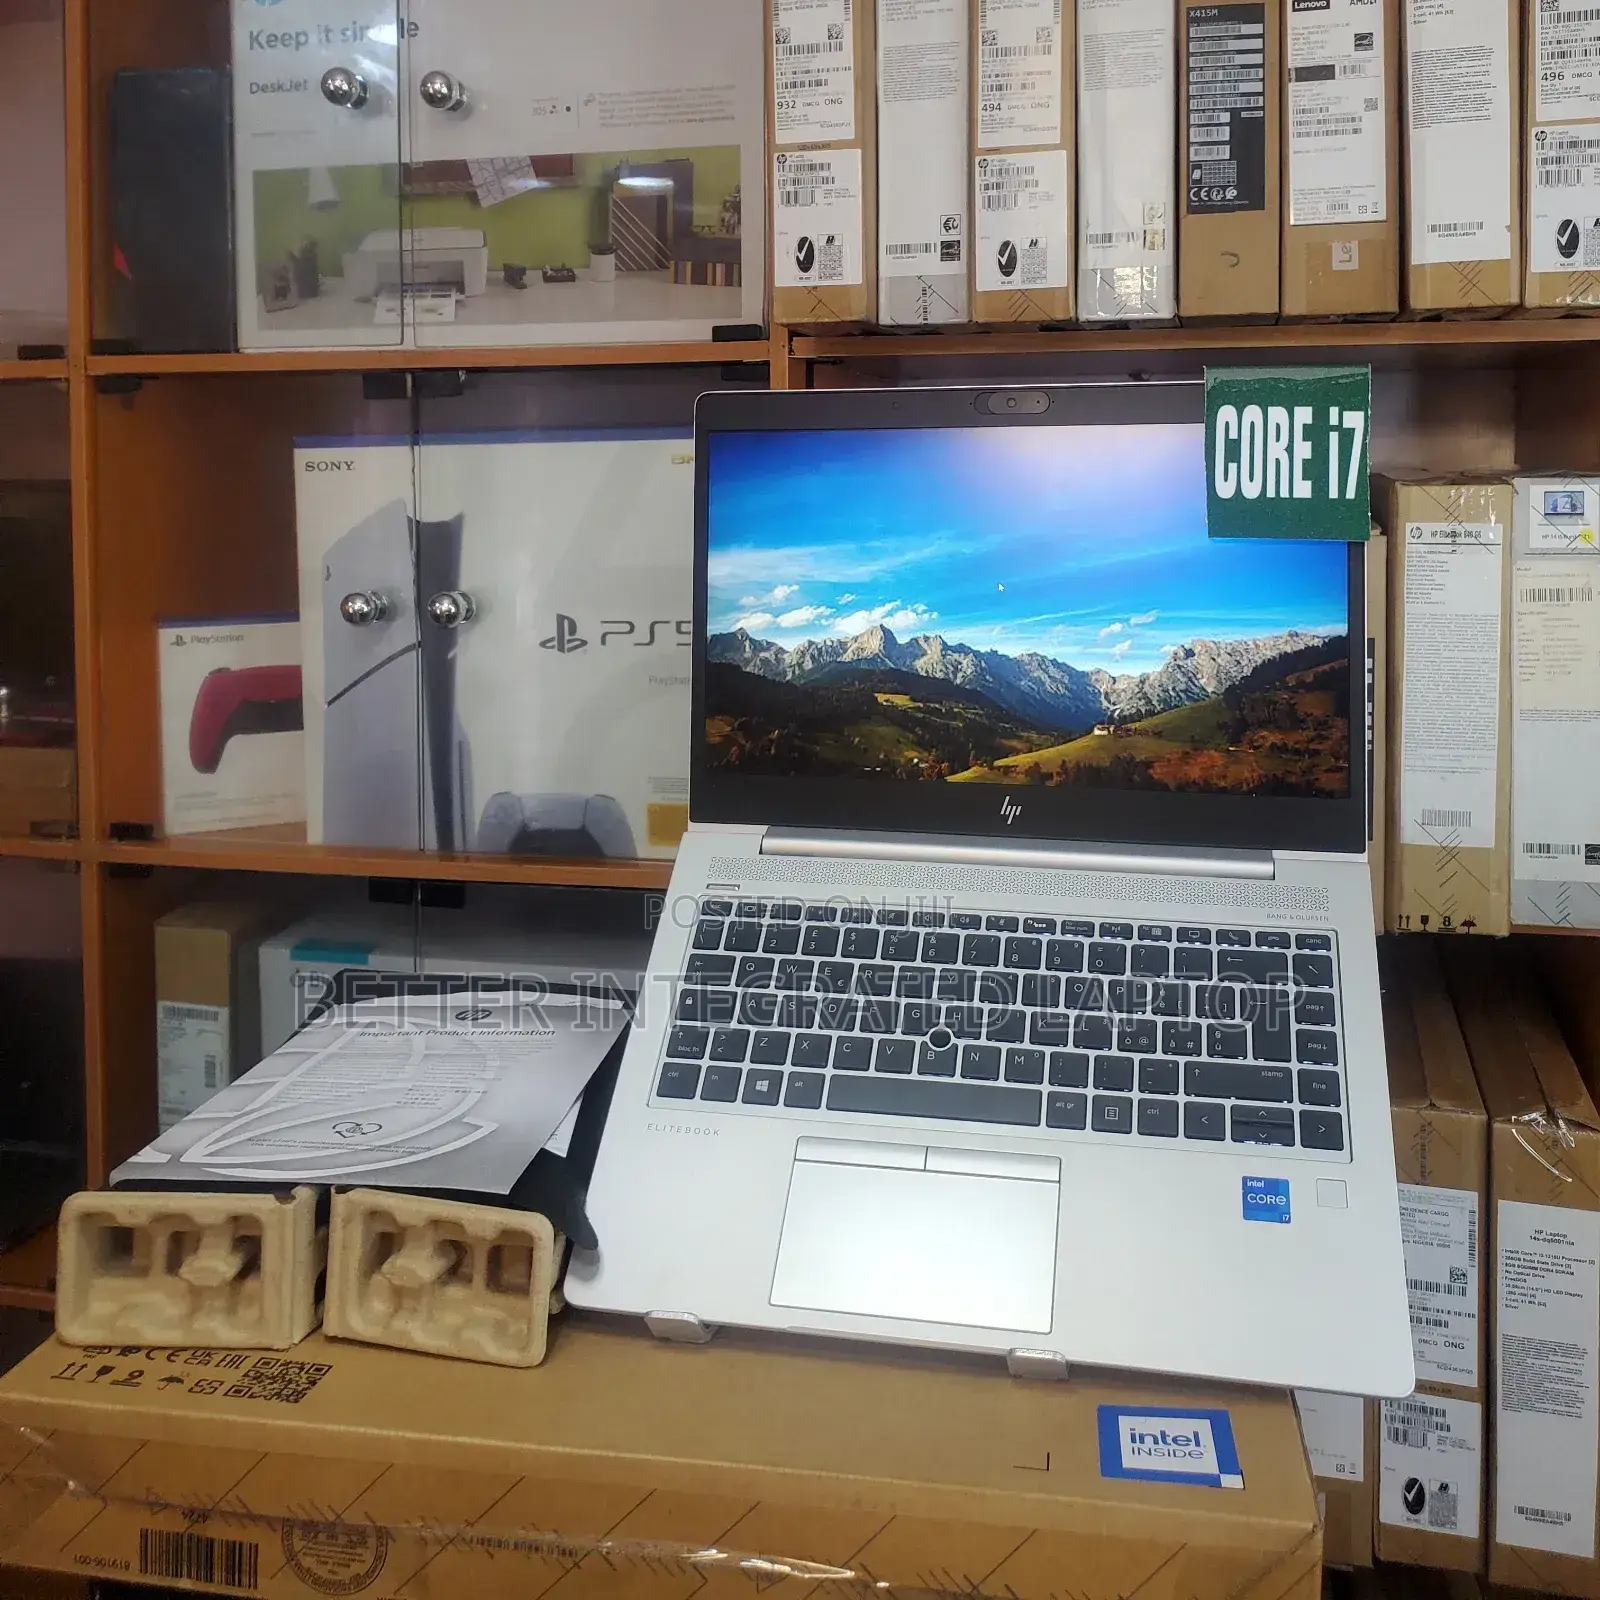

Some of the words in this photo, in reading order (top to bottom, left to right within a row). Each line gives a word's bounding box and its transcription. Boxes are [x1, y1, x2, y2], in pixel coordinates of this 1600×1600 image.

[1294, 1, 1327, 9] Lenovo
[1189, 8, 1218, 18] X415M
[249, 30, 309, 51] Keep
[317, 24, 331, 45] it
[1541, 71, 1565, 81] 496
[249, 78, 308, 95] DeskJet
[776, 99, 797, 110] 932
[824, 97, 843, 106] ONG
[981, 102, 1002, 112] 494
[1215, 404, 1313, 499] CORE
[1329, 406, 1365, 499] i7
[304, 460, 355, 472] SONY
[1430, 530, 1438, 538] HP
[600, 620, 692, 646] PS5
[191, 633, 244, 645] PlayStation
[770, 939, 777, 947] 2
[809, 942, 816, 950] 3
[888, 946, 895, 954] 5
[928, 948, 936, 956] 6
[970, 951, 976, 959] 7
[1011, 953, 1019, 962] 8
[1053, 956, 1061, 965] 9
[746, 962, 756, 972] Q
[786, 964, 798, 974] W
[824, 967, 833, 976] E
[864, 969, 873, 979] R
[1116, 986, 1125, 995] P
[748, 998, 757, 1008] A
[788, 1001, 796, 1010] S
[1305, 1002, 1320, 1013] pag
[828, 1003, 837, 1013] D
[911, 1009, 921, 1018] G
[953, 1012, 961, 1021] H
[1039, 1018, 1047, 1028] K
[1081, 1021, 1089, 1030] L
[359, 1030, 423, 1038] Important
[479, 1029, 556, 1037] Information
[760, 1038, 769, 1047] Z
[801, 1040, 810, 1050] X
[1307, 1041, 1322, 1051] pag
[842, 1043, 851, 1052] C
[885, 1046, 895, 1055] V
[926, 1051, 935, 1060] B
[970, 1053, 980, 1062] N
[1014, 1055, 1024, 1065] M
[1261, 1070, 1284, 1078] stamp
[794, 1080, 804, 1088] alt
[1312, 1081, 1326, 1090] fine
[1055, 1101, 1065, 1109] alt
[1147, 1107, 1160, 1115] ctrl
[647, 1123, 722, 1137] ELITEBOOK
[1247, 1179, 1265, 1189] intel
[1282, 1213, 1290, 1222] i7
[1430, 1209, 1449, 1217] CARGO
[1545, 1230, 1568, 1239] Laptop
[1561, 1256, 1588, 1264] Processor
[1564, 1291, 1584, 1299] Display
[1443, 1340, 1465, 1350] ONG
[1129, 1428, 1201, 1447] intel
